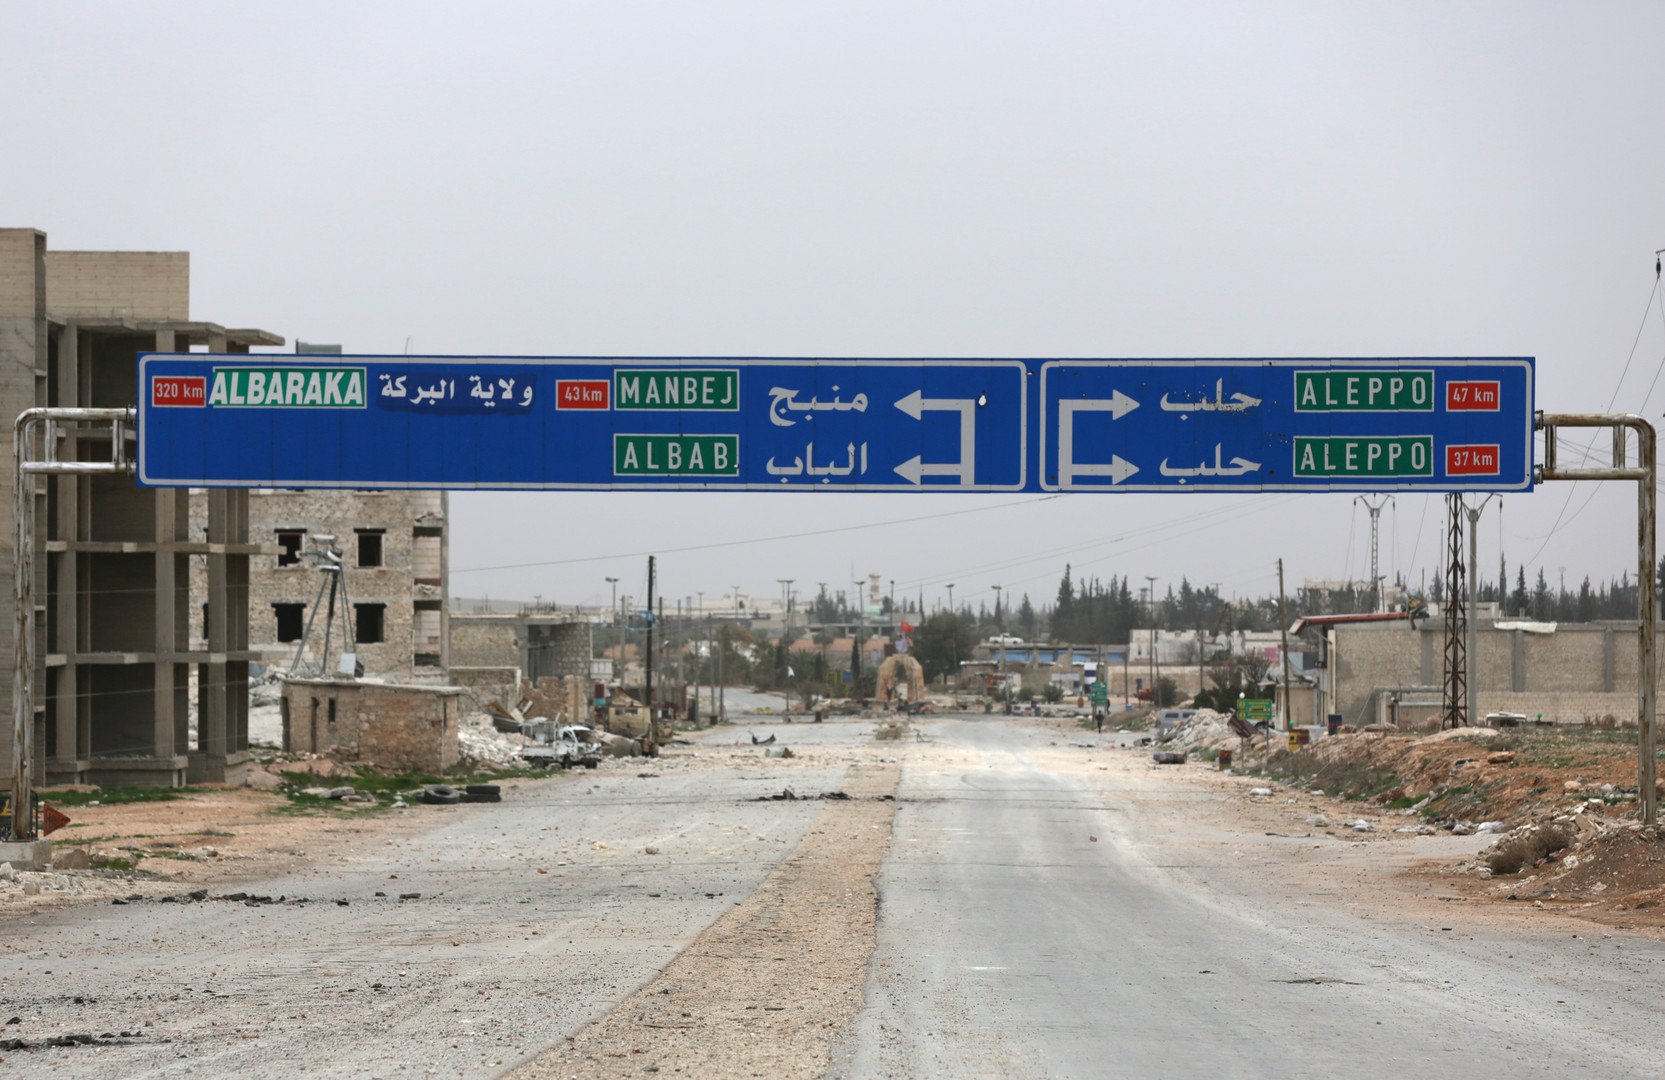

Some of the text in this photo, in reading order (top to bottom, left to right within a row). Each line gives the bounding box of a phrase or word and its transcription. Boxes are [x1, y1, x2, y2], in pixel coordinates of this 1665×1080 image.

[156, 382, 203, 398] 320 km
[209, 371, 362, 405] ALBARAKA
[378, 373, 533, 407] ولاية البركة
[565, 386, 603, 402] 43 km
[620, 376, 732, 405] MANBEJ
[1159, 377, 1263, 421] حلب
[1301, 376, 1426, 406] ALEPPO
[1452, 387, 1494, 403] 47 km
[768, 384, 869, 427] منبج
[622, 441, 728, 470] ALBAB
[765, 440, 867, 484] الباب
[1159, 441, 1263, 485] حلب
[1300, 441, 1426, 471] ALEPPO
[1453, 451, 1493, 467] 37 km
